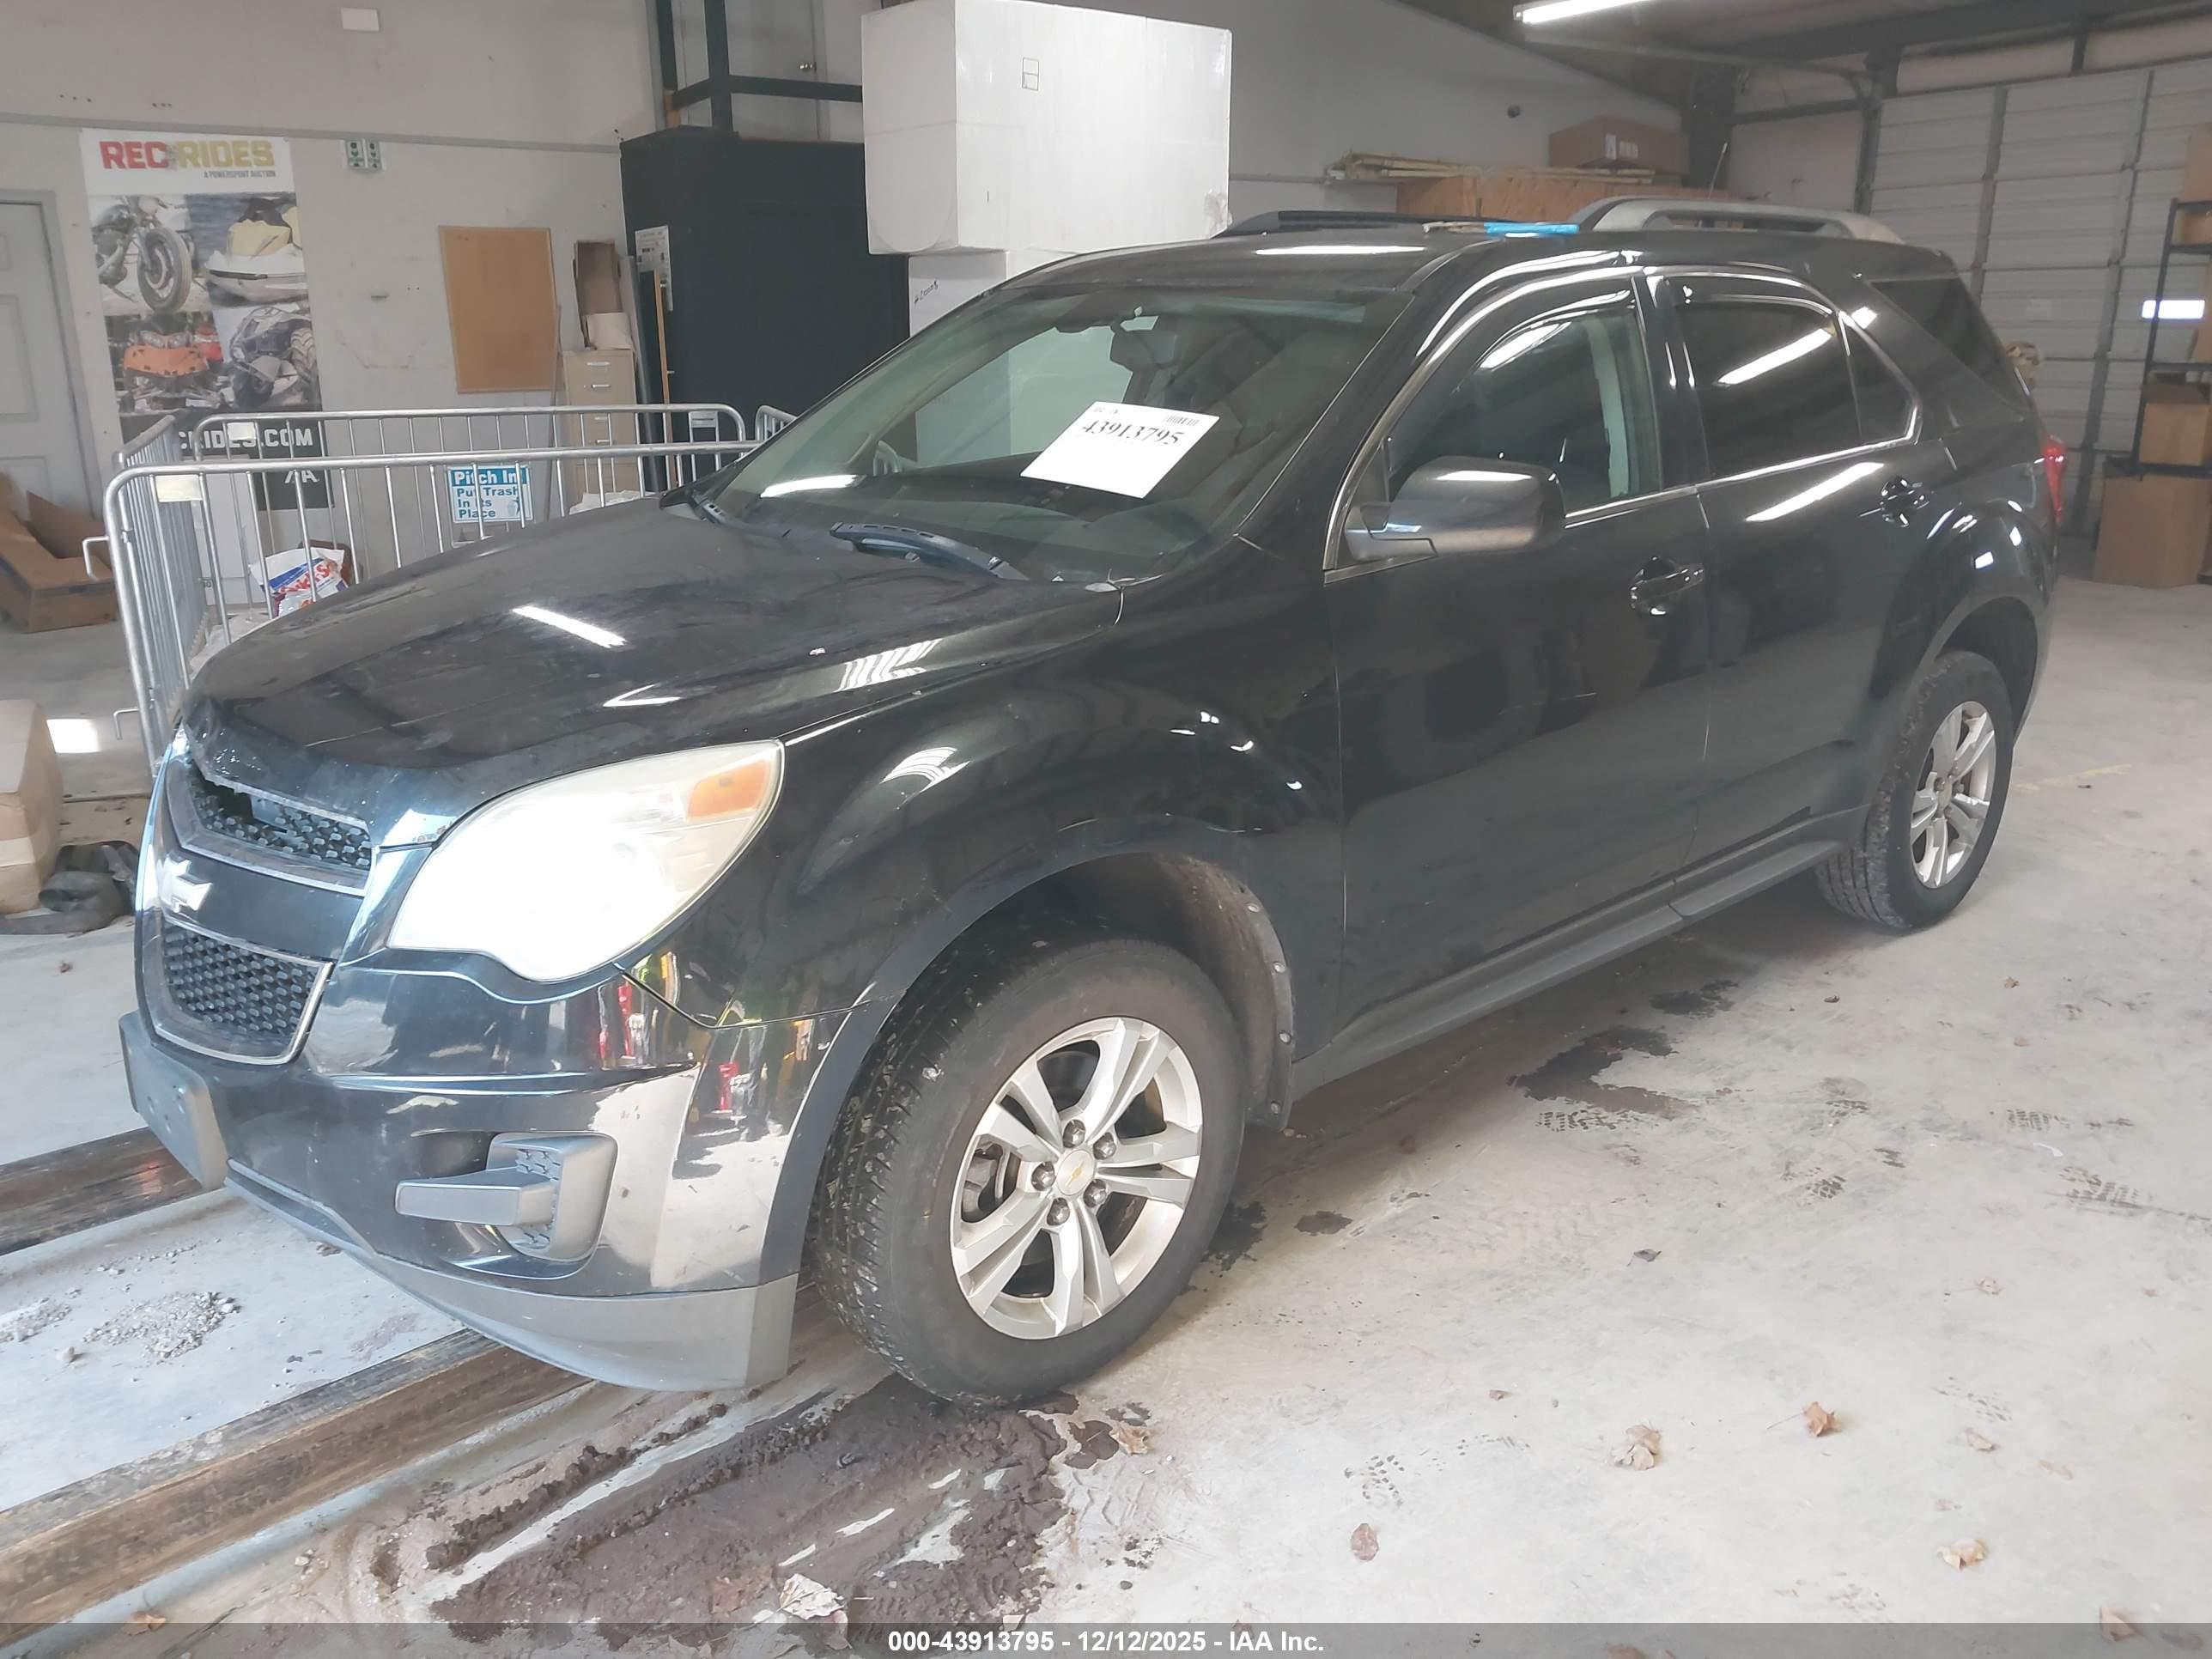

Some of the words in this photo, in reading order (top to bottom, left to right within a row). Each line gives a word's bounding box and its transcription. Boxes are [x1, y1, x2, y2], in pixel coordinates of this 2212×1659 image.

[99, 141, 168, 168] REC
[177, 140, 275, 167] RIDES
[1083, 419, 1184, 445] 43913795
[502, 469, 520, 483] In
[458, 499, 471, 507] In
